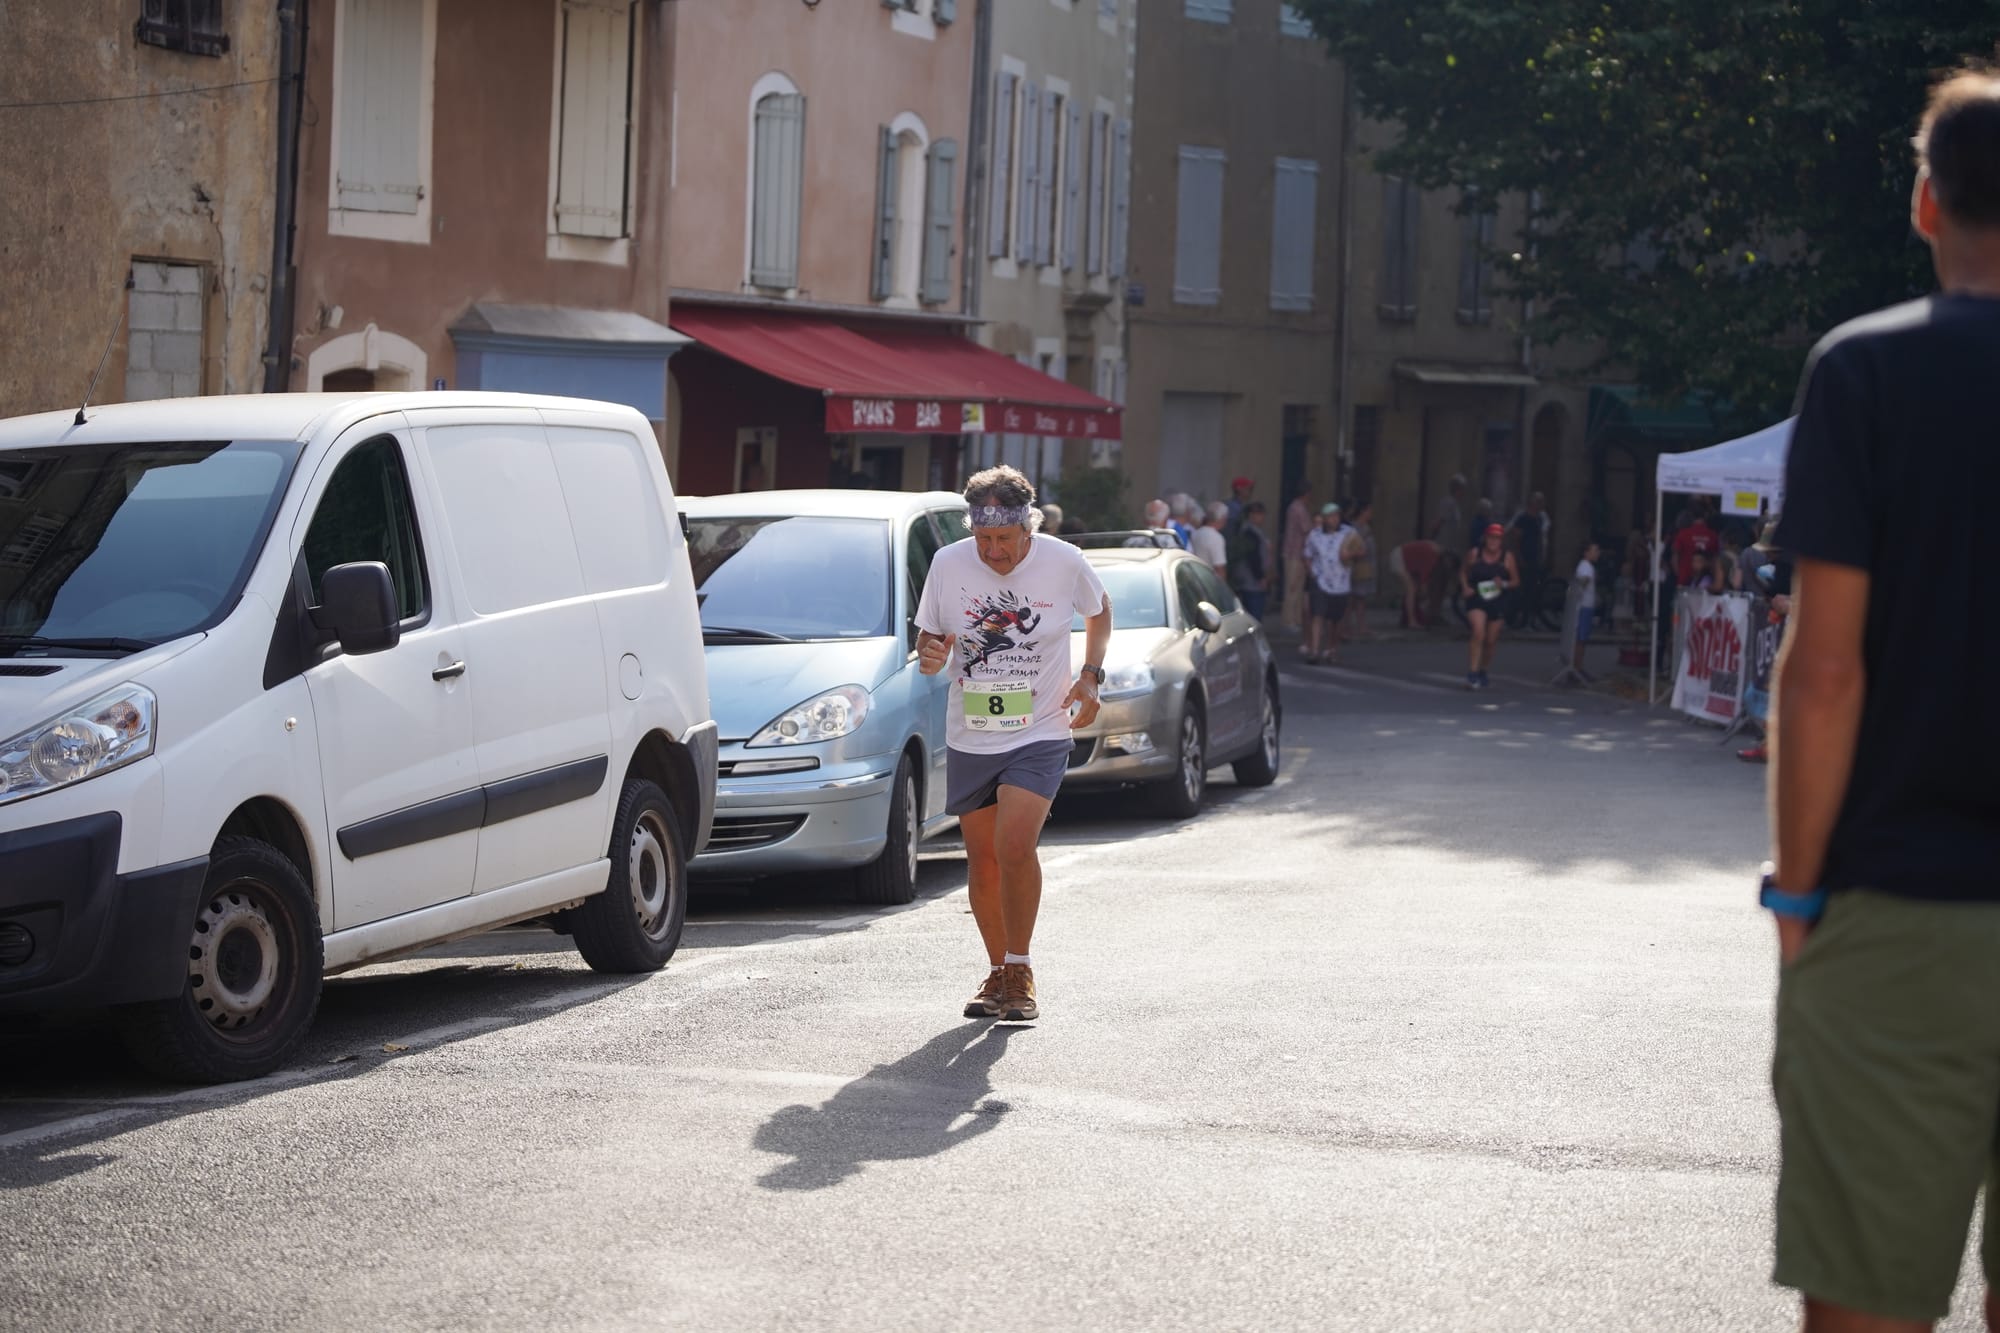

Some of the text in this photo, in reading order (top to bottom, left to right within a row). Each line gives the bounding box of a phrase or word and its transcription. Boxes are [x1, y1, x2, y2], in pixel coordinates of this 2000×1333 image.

[853, 400, 941, 427] RYAN'S BAR
[977, 664, 1041, 677] SAINT ROMAN
[988, 695, 1005, 715] 8
